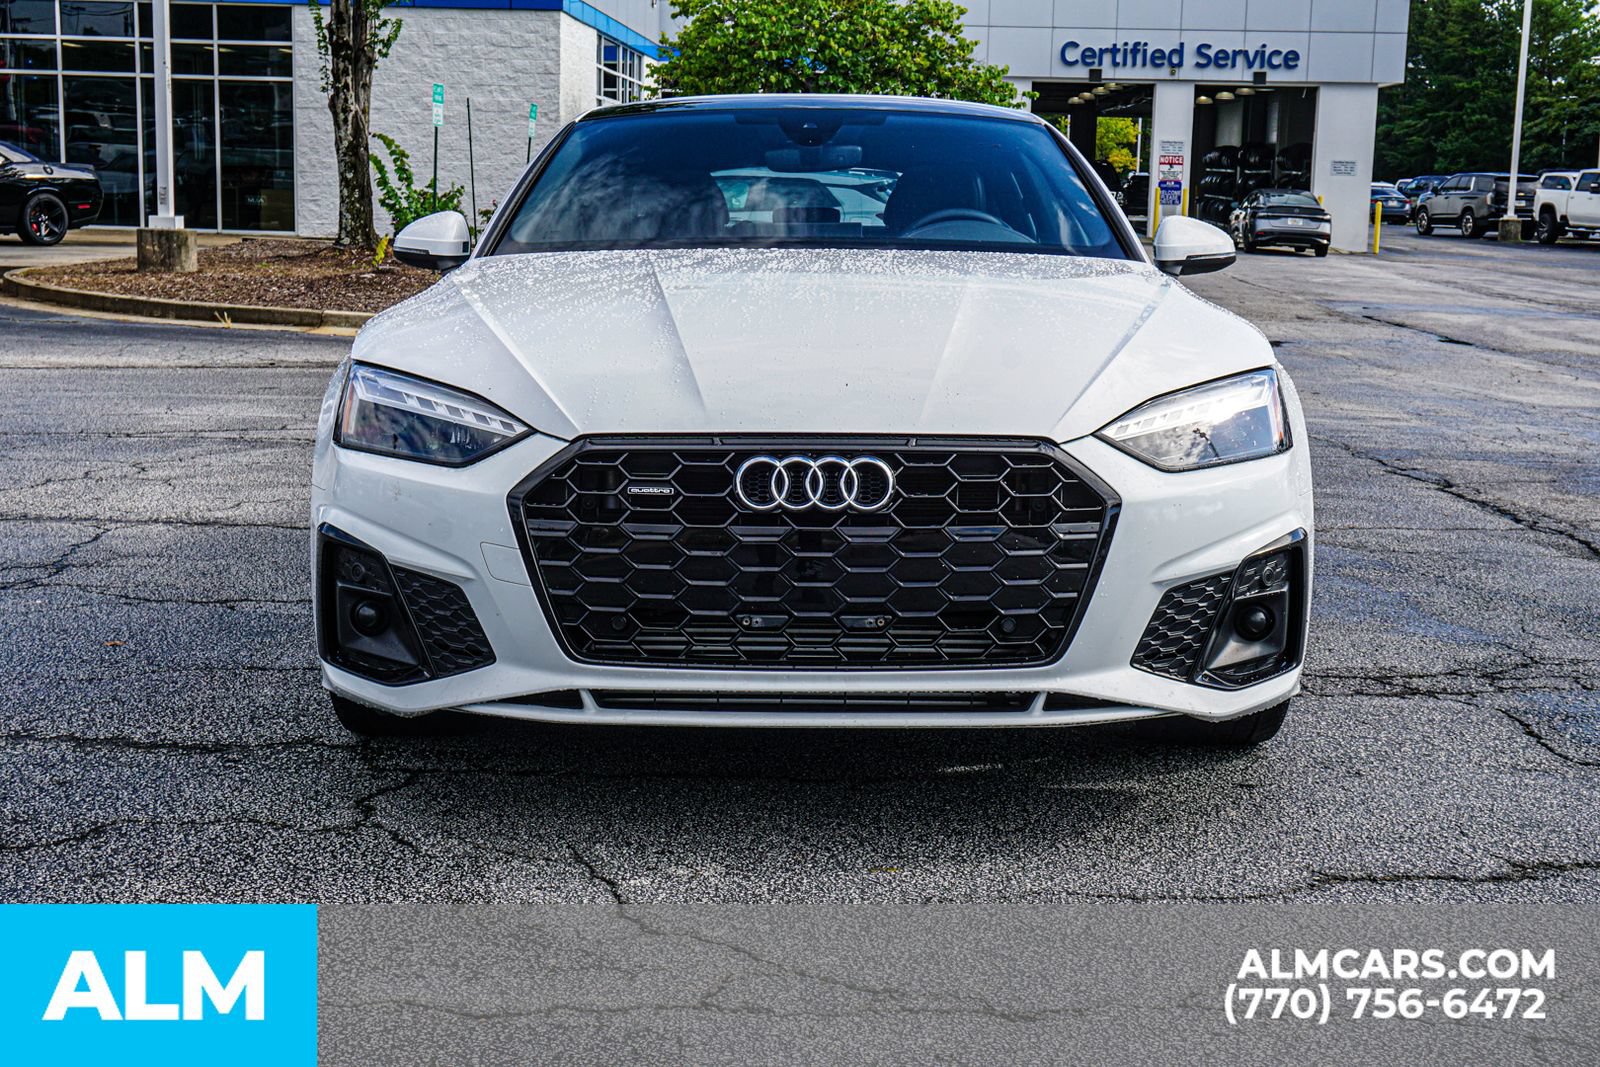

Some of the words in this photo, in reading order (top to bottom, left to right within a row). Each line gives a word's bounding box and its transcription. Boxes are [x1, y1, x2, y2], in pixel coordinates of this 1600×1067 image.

[1060, 41, 1185, 68] Certified
[1195, 43, 1300, 70] Service
[1160, 156, 1183, 164] NOTICE
